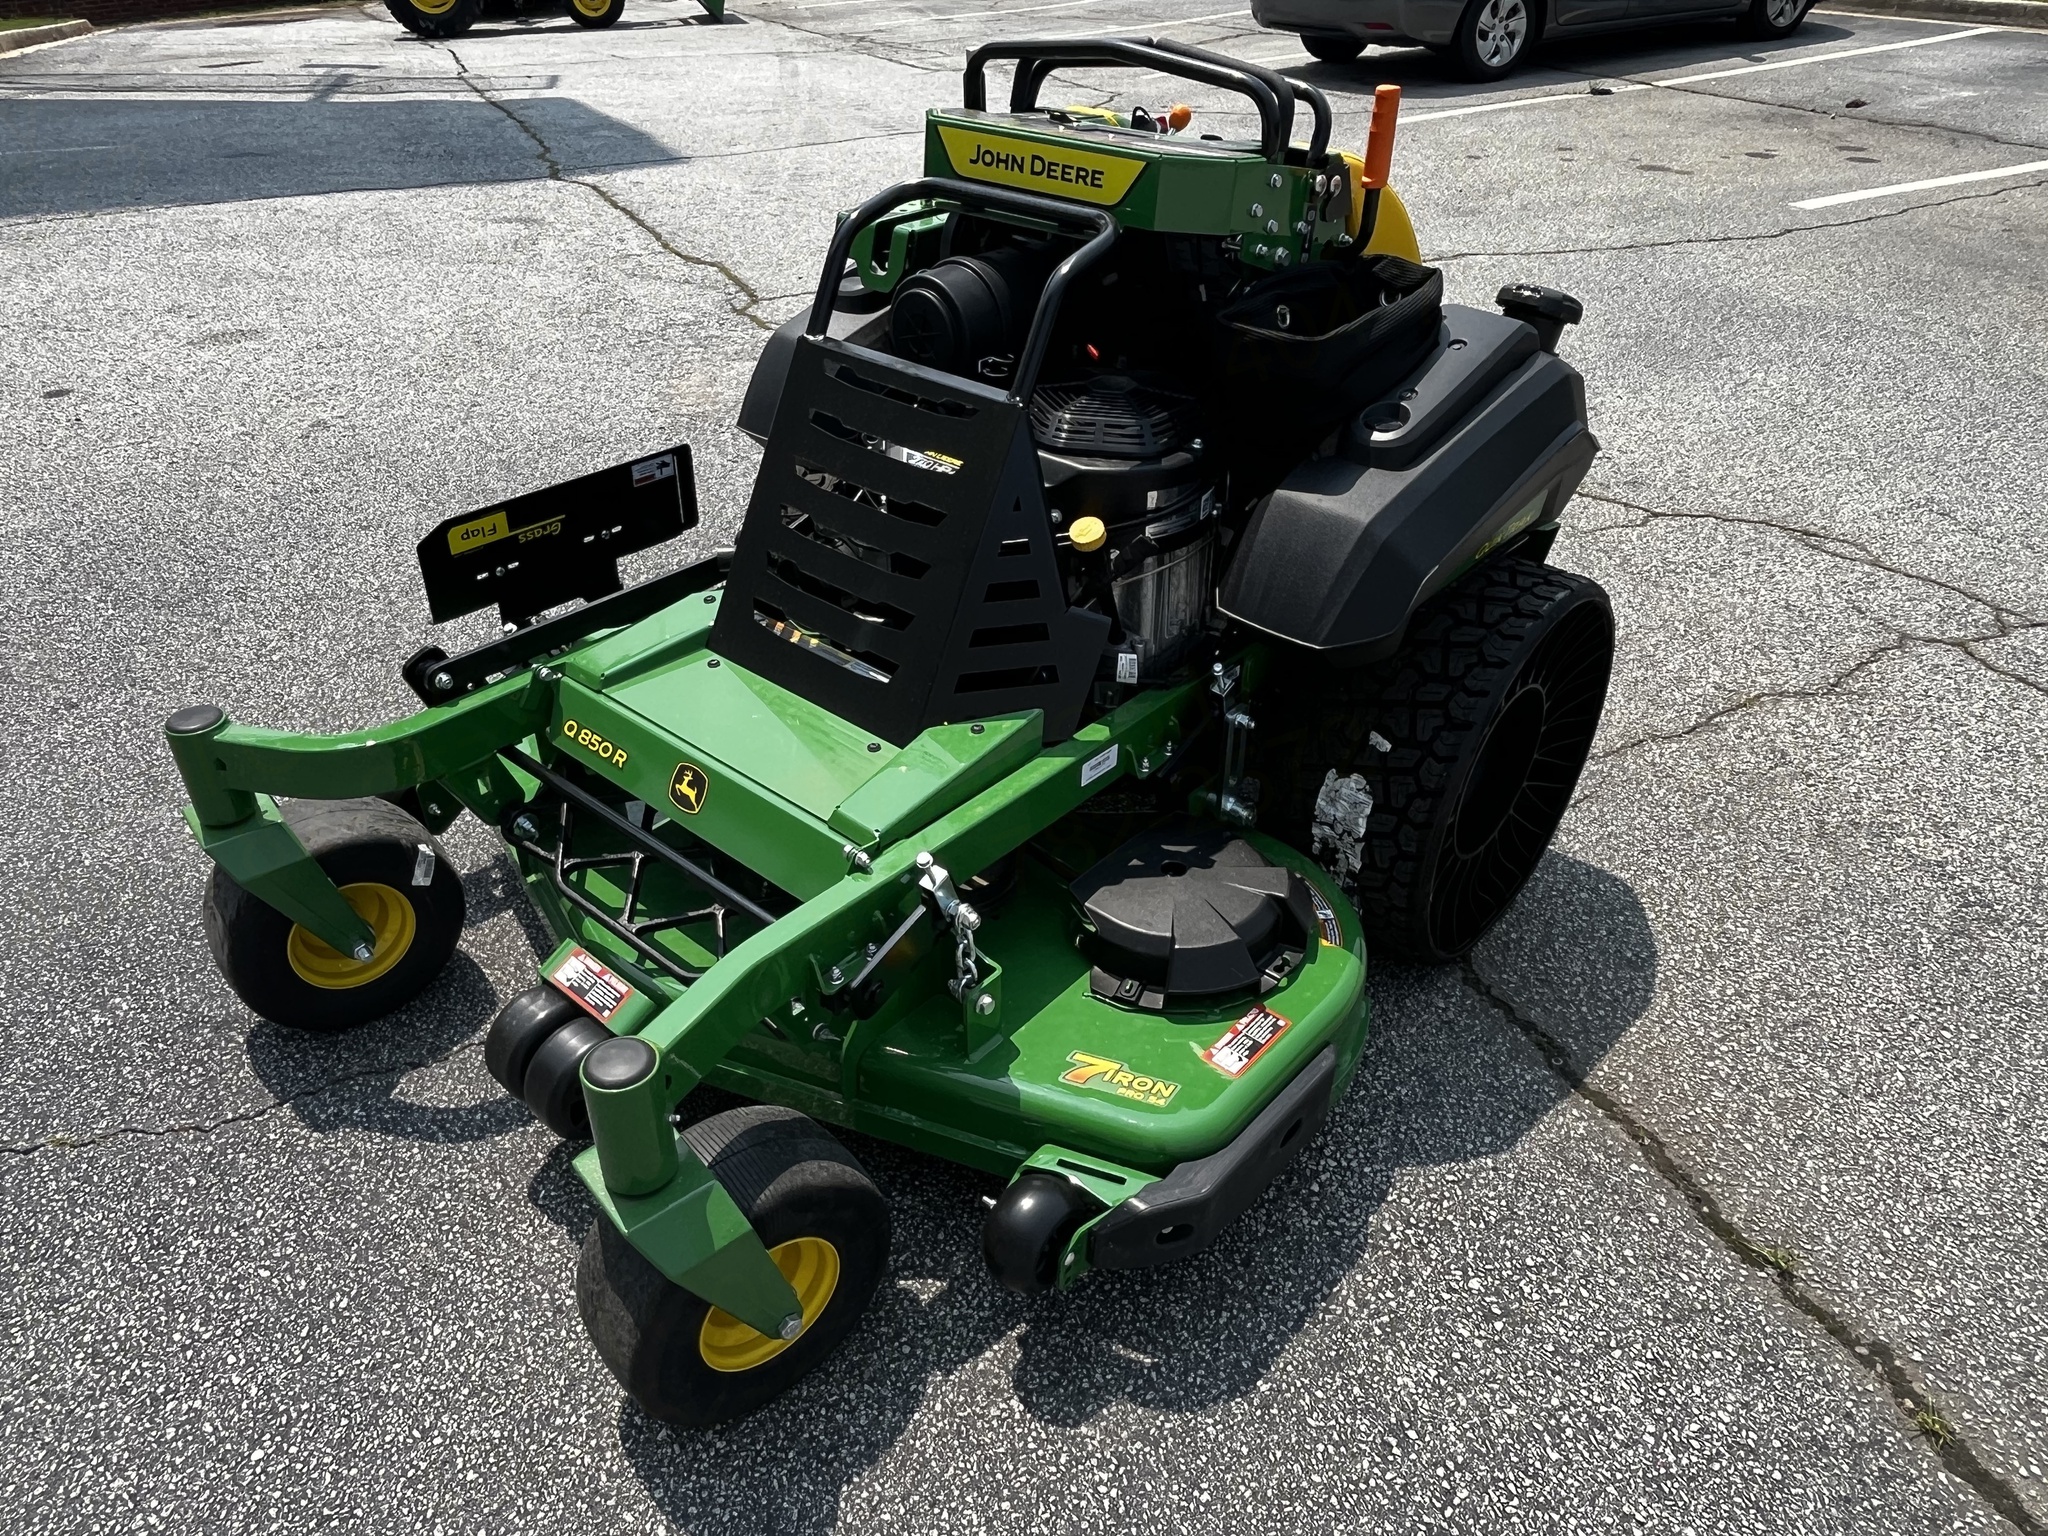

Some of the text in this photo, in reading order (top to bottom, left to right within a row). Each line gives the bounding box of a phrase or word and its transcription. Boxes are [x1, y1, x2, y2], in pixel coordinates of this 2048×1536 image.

[969, 144, 1105, 189] JOHN DEERE
[460, 521, 562, 544] Grass Flap
[564, 720, 628, 768] Q 850 R
